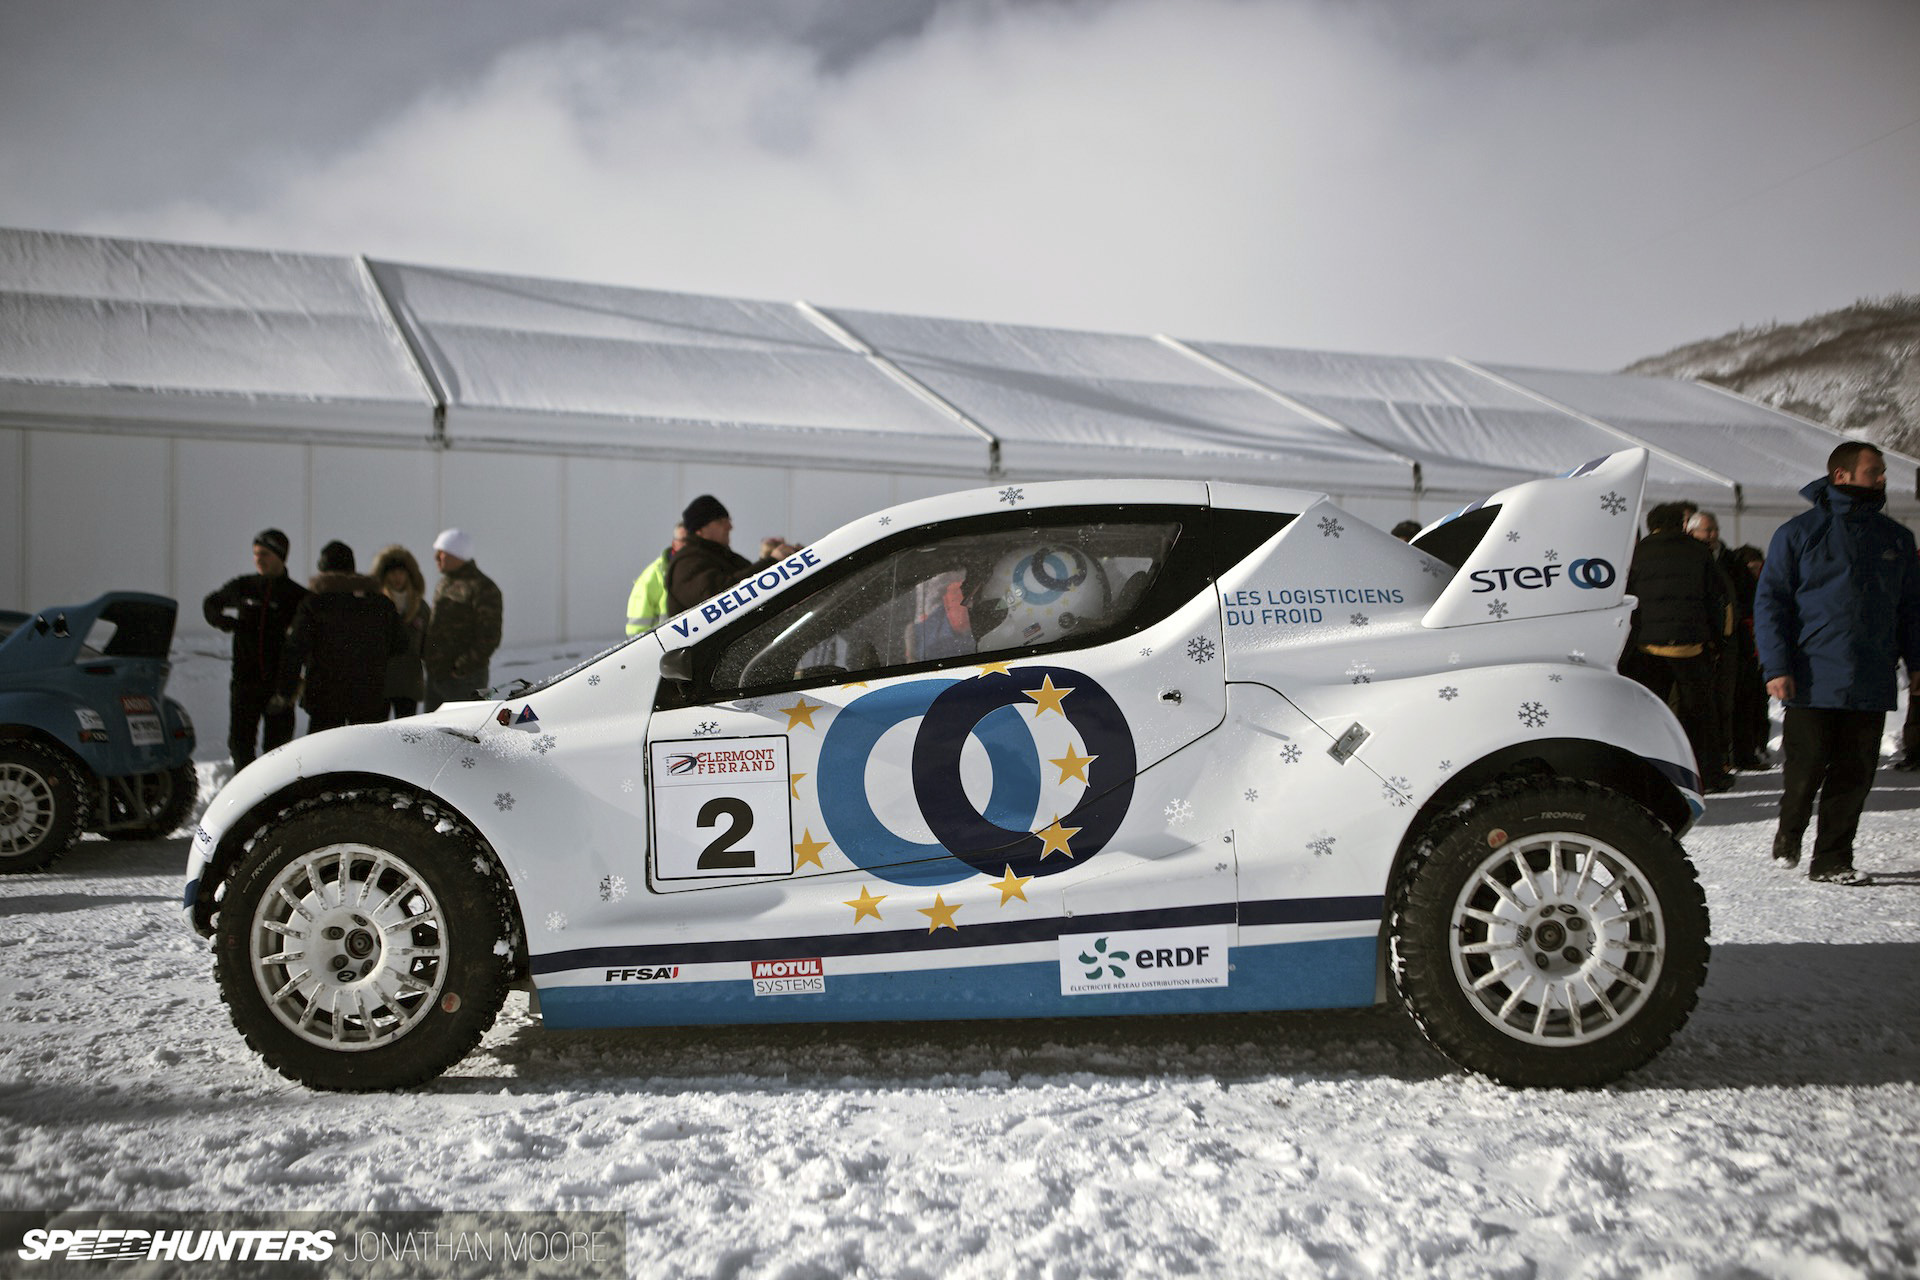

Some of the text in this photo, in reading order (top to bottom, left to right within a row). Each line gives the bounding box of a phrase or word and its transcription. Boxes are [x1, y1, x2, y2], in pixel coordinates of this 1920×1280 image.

[671, 549, 822, 638] V. BELTOISE
[1223, 589, 1404, 606] LES LOGISTICIENS
[1226, 608, 1323, 626] DU FROID
[696, 749, 774, 763] CLERMONT
[697, 760, 775, 774] FERRAND
[696, 796, 756, 870] 2
[605, 967, 672, 982] FFSA
[755, 960, 820, 977] MOTUL
[756, 978, 823, 993] SYSTEMS
[1142, 979, 1190, 988] DISTRIBUTION
[1191, 977, 1219, 985] FRANCE
